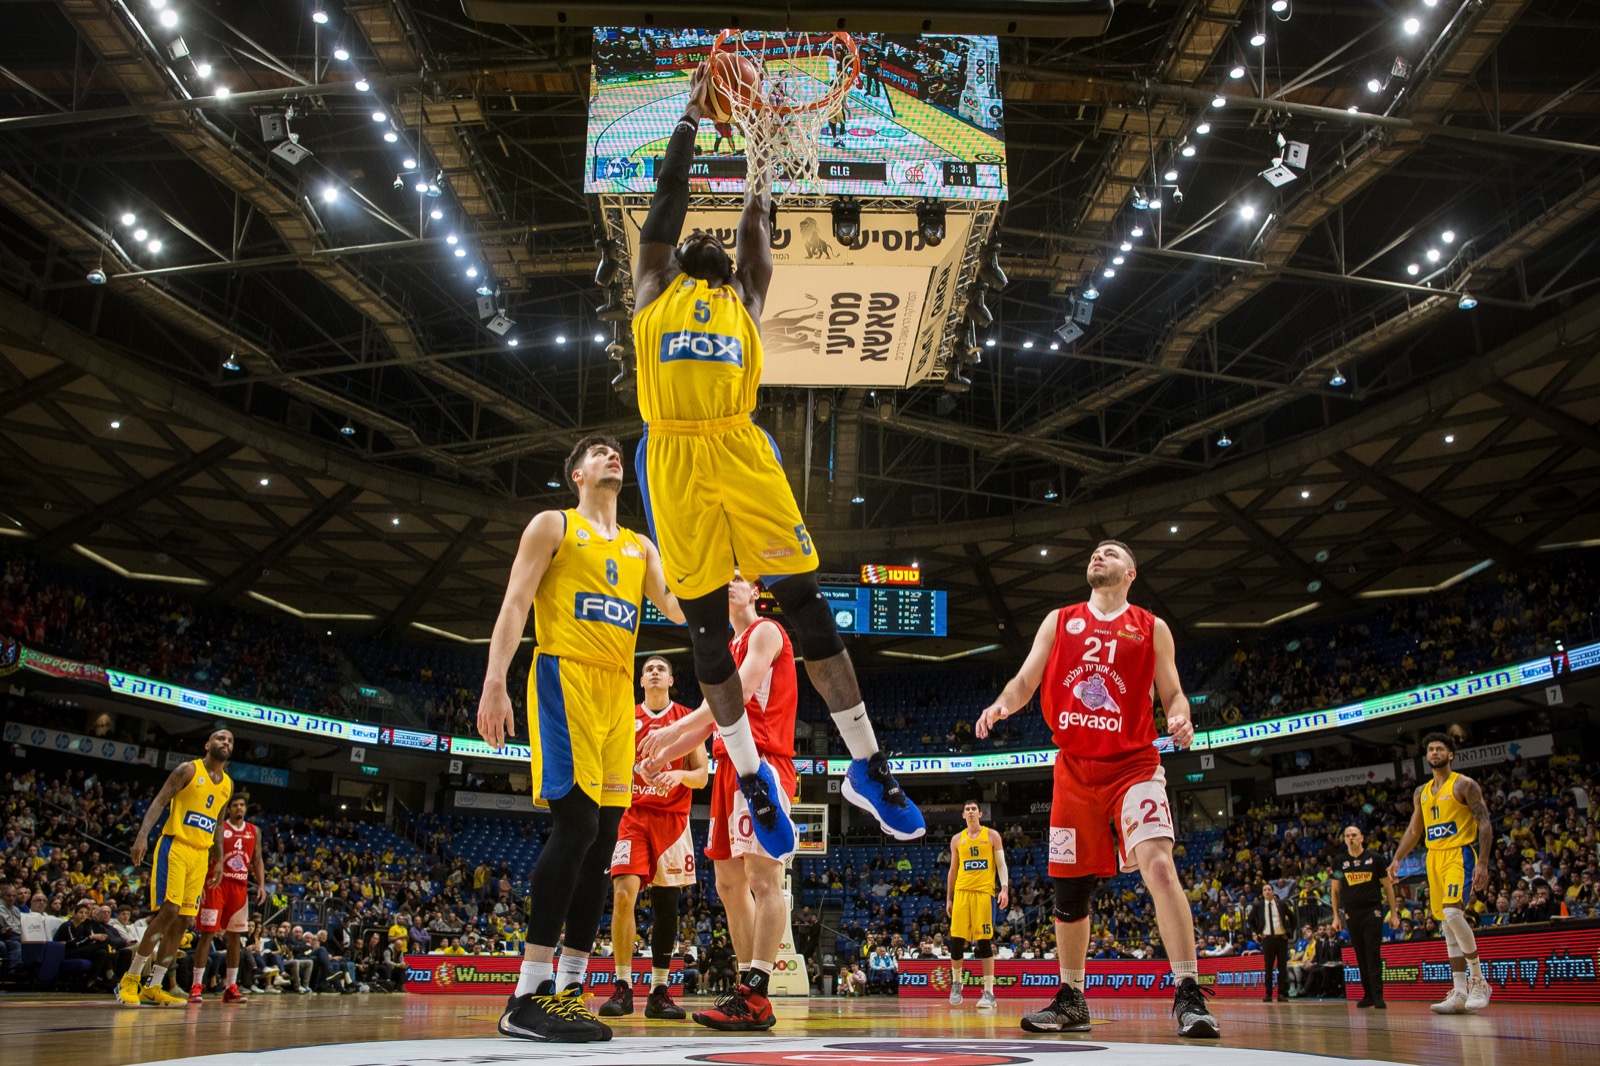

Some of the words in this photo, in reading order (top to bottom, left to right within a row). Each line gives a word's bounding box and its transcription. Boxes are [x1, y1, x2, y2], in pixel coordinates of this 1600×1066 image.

[829, 164, 851, 177] GLG
[950, 164, 968, 174] 3:36
[962, 175, 971, 185] 13
[693, 299, 711, 324] 5
[826, 292, 863, 356] מסיעי
[860, 292, 901, 362] שאשא
[668, 335, 738, 361] FOX
[794, 523, 812, 556] 5
[605, 558, 619, 587] 8
[888, 569, 920, 581] טוטו
[582, 597, 636, 629] FOX
[1082, 636, 1118, 664] 21
[1521, 663, 1551, 679] teva
[1553, 654, 1565, 675] 7
[131, 679, 172, 699] חזק
[1467, 670, 1511, 694] חזק
[181, 693, 207, 707] teva
[1550, 689, 1558, 701] 7
[1059, 710, 1123, 733] gevasol
[1288, 713, 1328, 732] חזק
[1338, 709, 1363, 721] teva
[305, 717, 343, 734] חזק
[352, 727, 377, 739] teva
[380, 729, 390, 745] 4
[439, 737, 449, 752] 5
[354, 749, 362, 760] 4
[453, 762, 459, 772] 5
[815, 761, 827, 774] 6
[909, 756, 942, 772] חזק
[950, 761, 972, 769] teva
[1204, 757, 1211, 768] 7
[830, 782, 837, 792] 6
[206, 794, 215, 809] 9
[1430, 806, 1440, 820] 11
[187, 813, 217, 832] FOX
[1427, 825, 1454, 839] FOX
[233, 838, 243, 850] 4
[969, 846, 979, 857] 15
[684, 854, 695, 873] 8
[965, 860, 987, 870] FOX
[1447, 884, 1458, 898] 11
[982, 924, 991, 935] 15
[1021, 973, 1059, 986] המכה!
[1492, 961, 1517, 986] דקה
[1520, 960, 1539, 986] קח
[1085, 974, 1103, 989] ותן
[1108, 974, 1132, 989] דקה
[1137, 975, 1155, 989] קח
